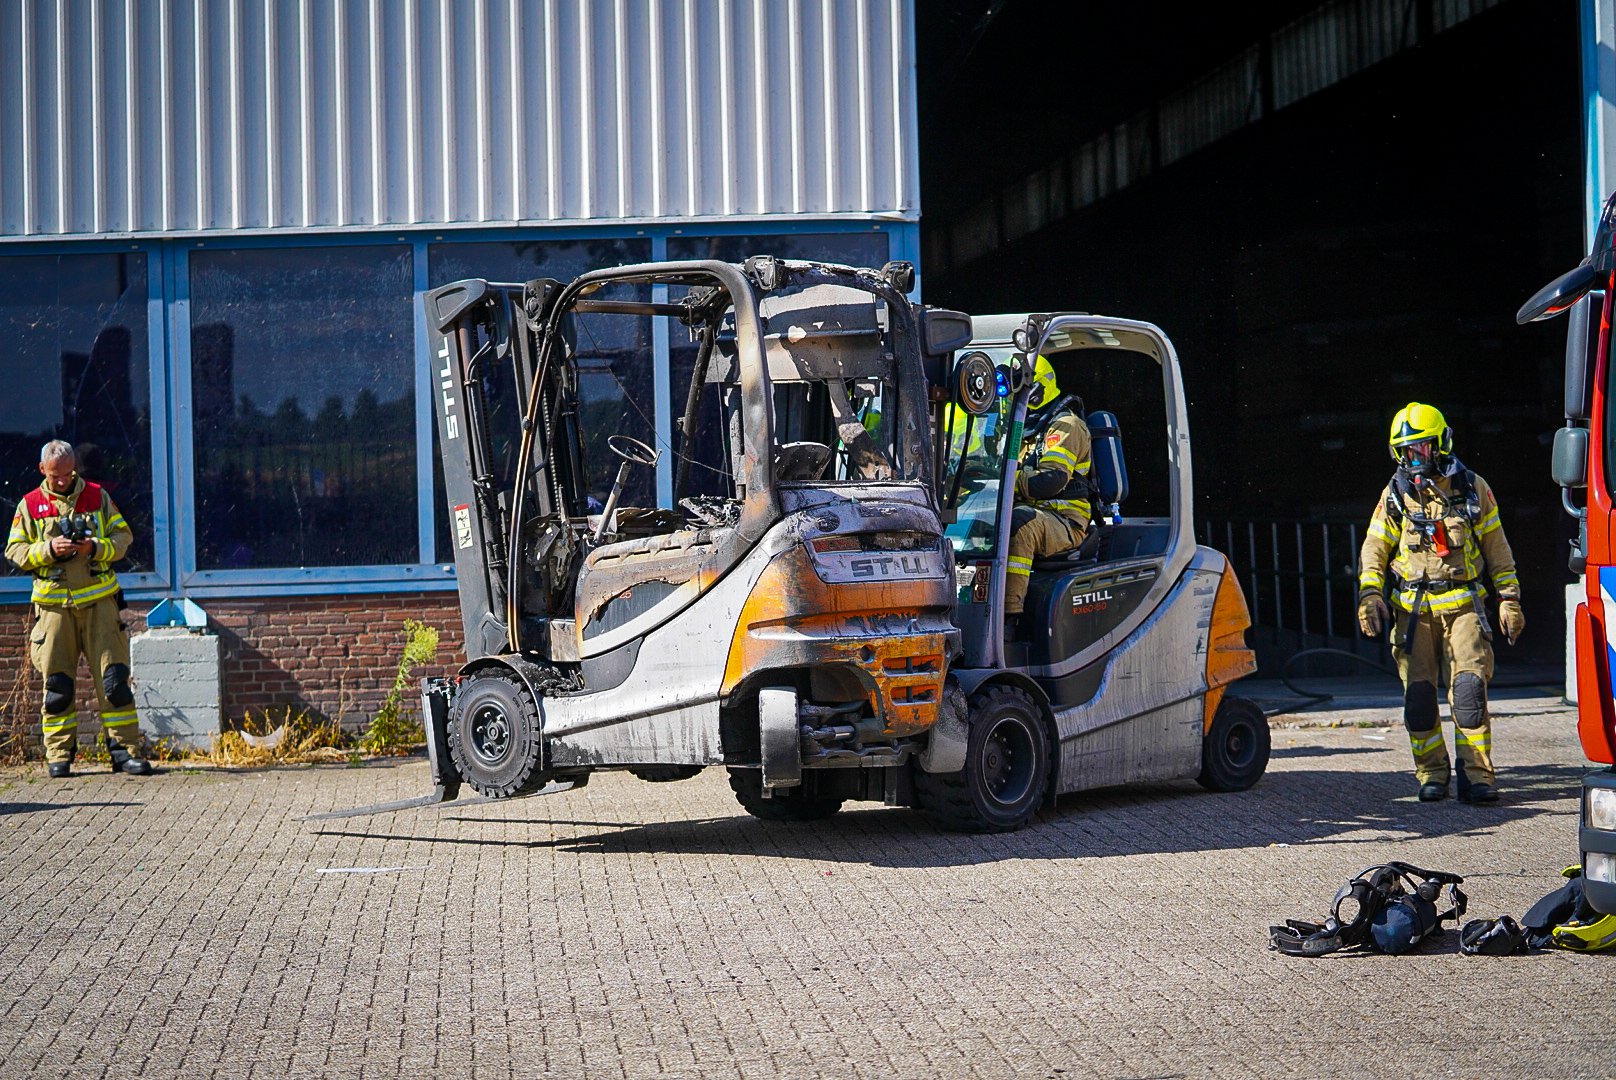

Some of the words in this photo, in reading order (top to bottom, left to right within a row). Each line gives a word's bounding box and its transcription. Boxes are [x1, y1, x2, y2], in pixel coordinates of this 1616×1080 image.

[438, 336, 459, 440] STILL
[851, 555, 929, 577] STLL
[1072, 590, 1113, 606] STILL
